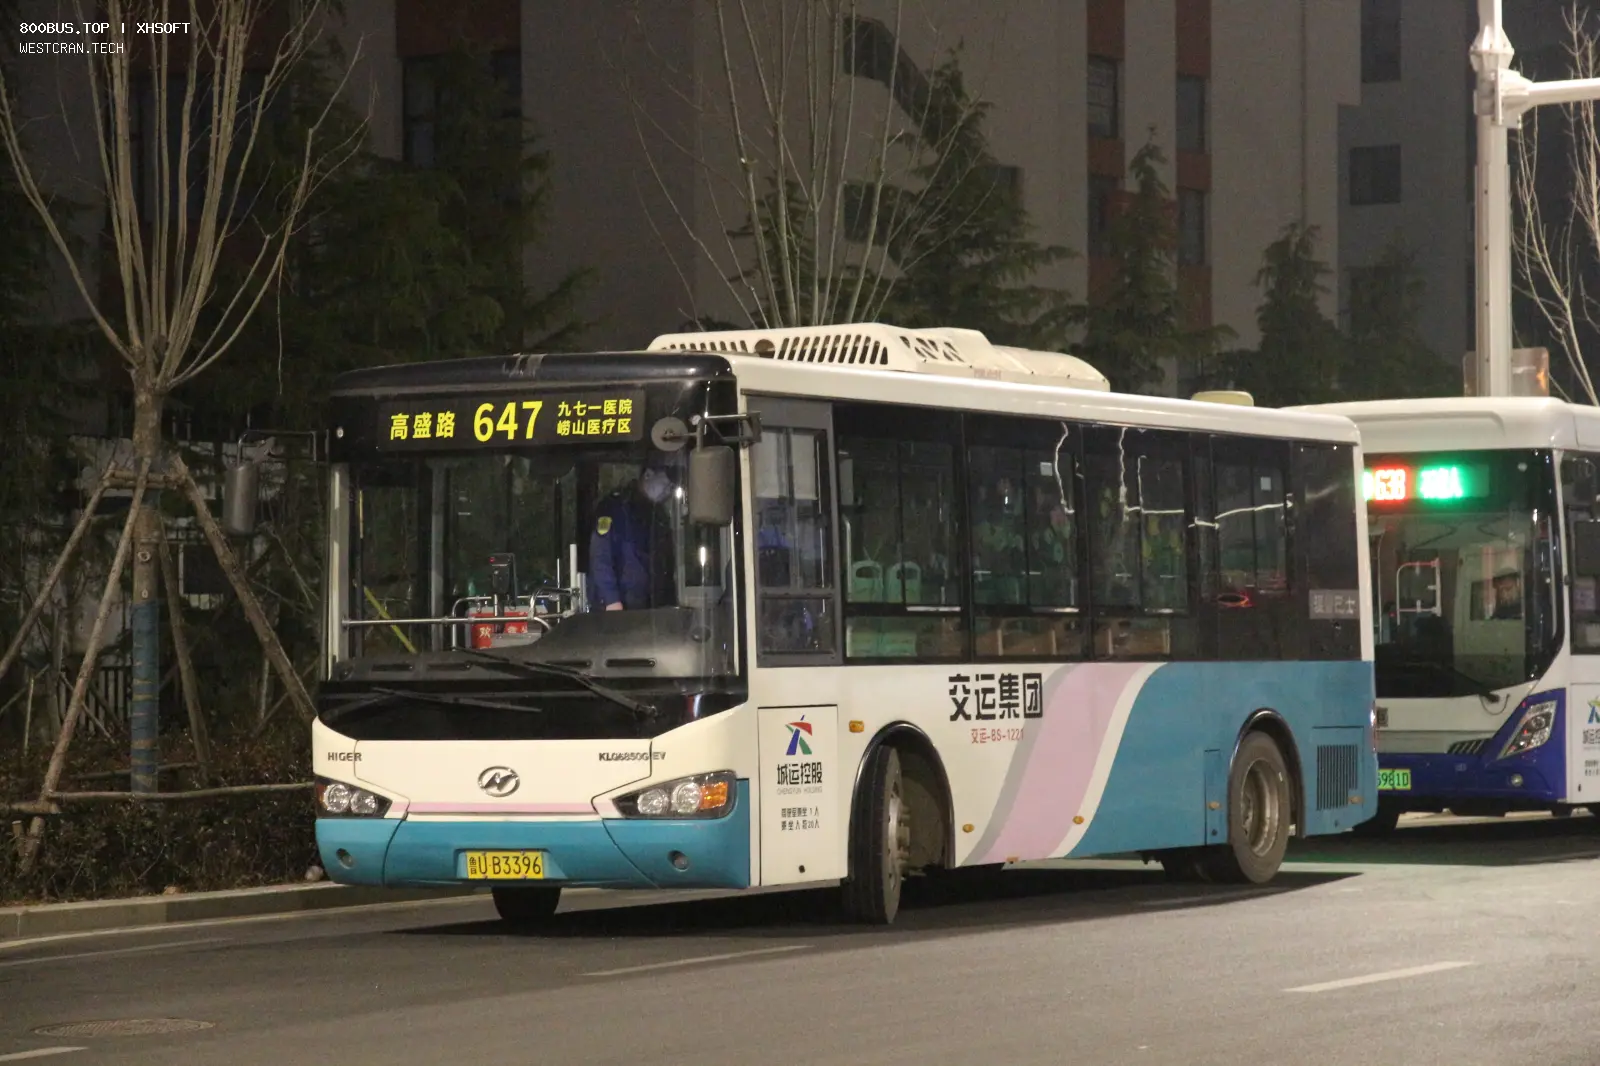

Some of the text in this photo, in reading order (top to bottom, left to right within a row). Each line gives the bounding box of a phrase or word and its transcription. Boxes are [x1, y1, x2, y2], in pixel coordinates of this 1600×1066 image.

[557, 399, 633, 417] 九七一医院
[390, 411, 455, 440] 高盛路
[473, 401, 543, 442] 647
[556, 418, 632, 436] 崂山医疗区
[948, 673, 1043, 721] 交运集团
[971, 728, 1024, 744] 交运-BS-1221
[327, 752, 362, 761] HIGER
[777, 762, 823, 785] 城运控股
